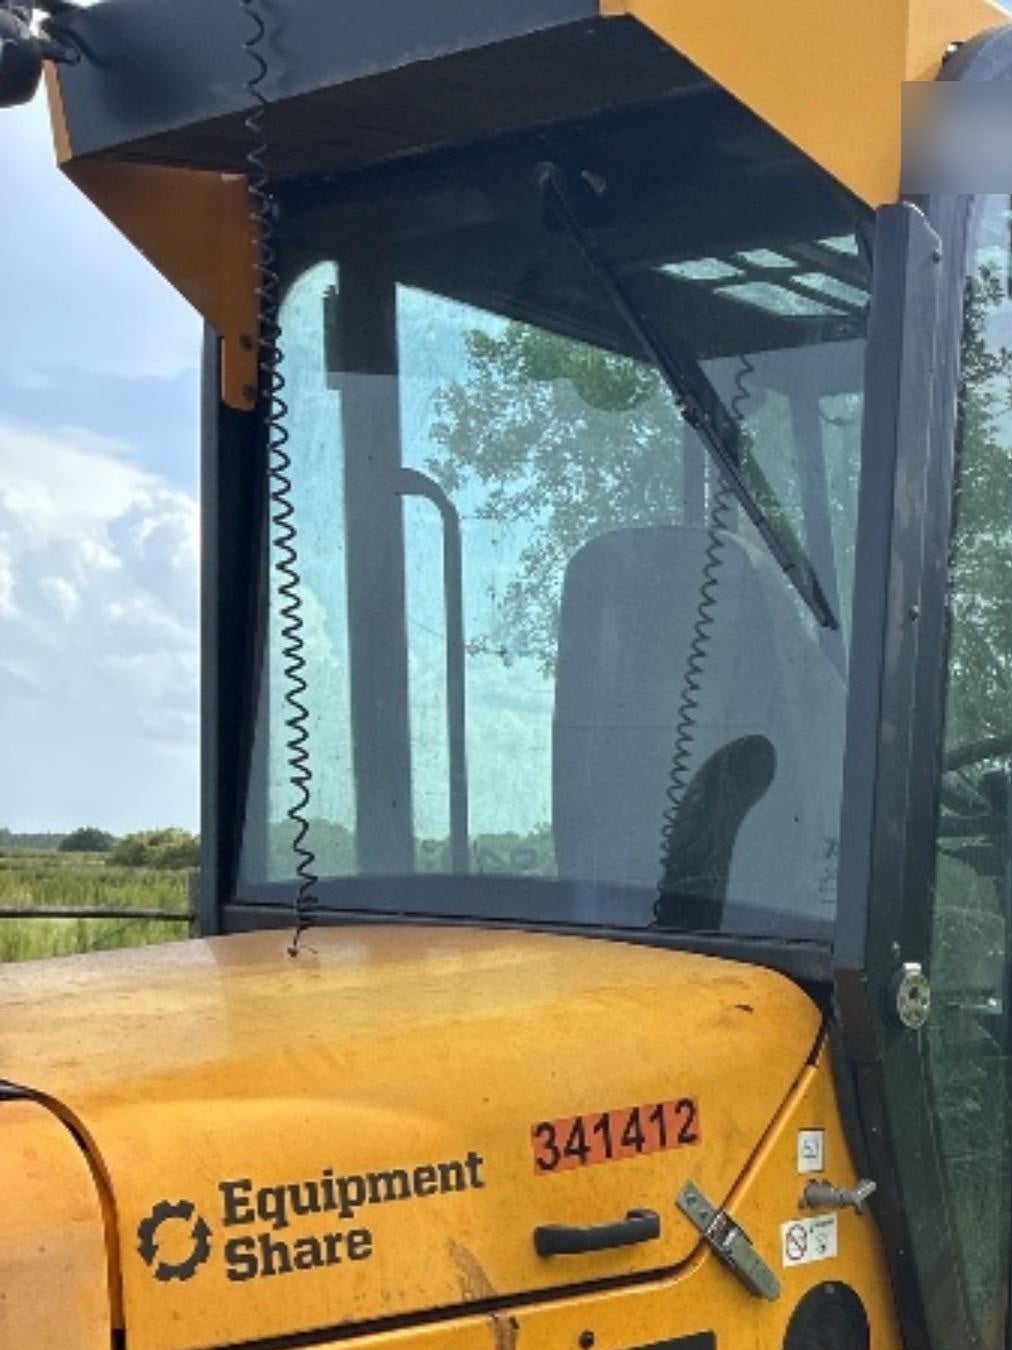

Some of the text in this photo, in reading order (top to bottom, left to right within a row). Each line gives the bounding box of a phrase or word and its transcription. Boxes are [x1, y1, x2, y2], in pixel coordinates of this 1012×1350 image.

[532, 1098, 698, 1172] 341412
[218, 1150, 485, 1230] Equipment
[225, 1225, 373, 1283] Share
